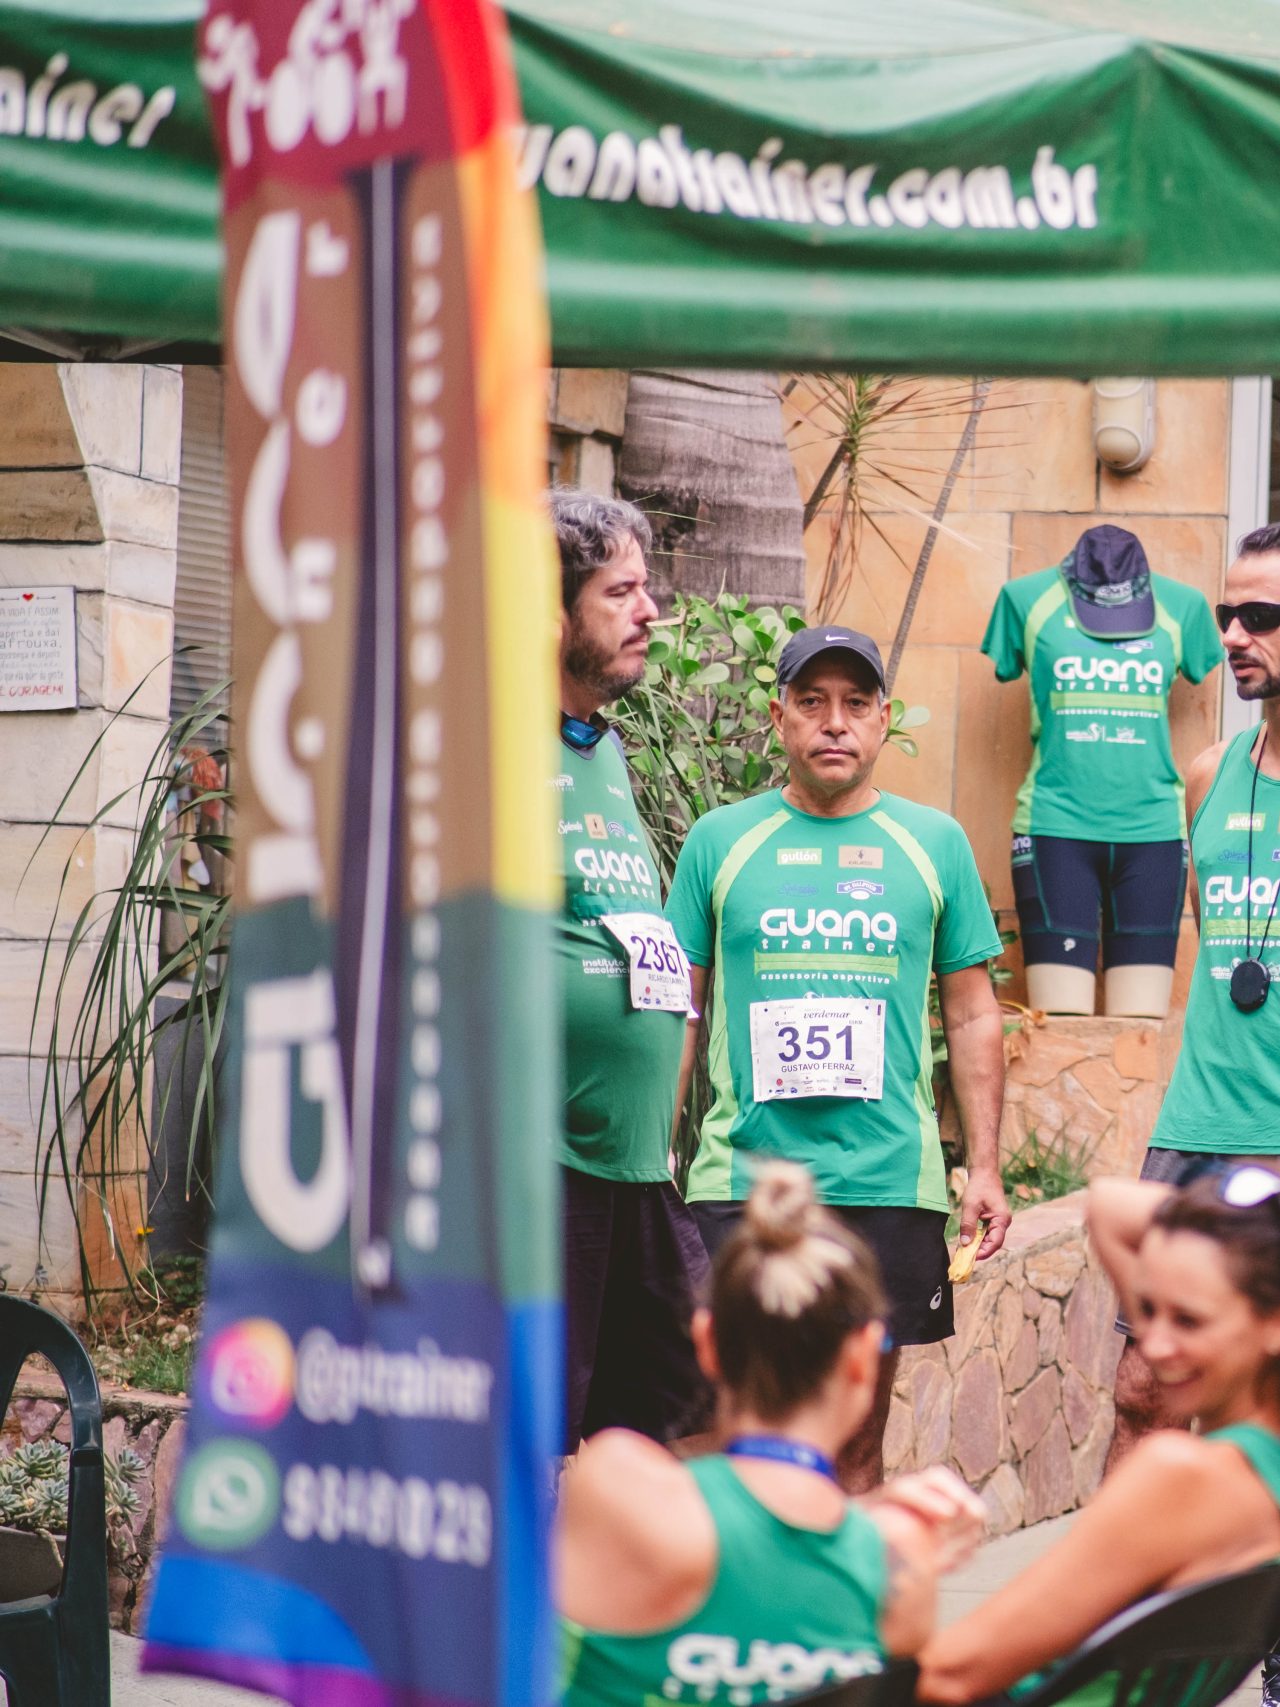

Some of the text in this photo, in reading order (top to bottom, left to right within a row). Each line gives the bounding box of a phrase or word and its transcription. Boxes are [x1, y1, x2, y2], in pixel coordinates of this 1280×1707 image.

[762, 938, 896, 954] trainer
[630, 935, 686, 978] 2367
[803, 1009, 851, 1020] verdemar
[777, 1025, 853, 1063] 351
[781, 1062, 856, 1073] GUSTAVO FERRAZ
